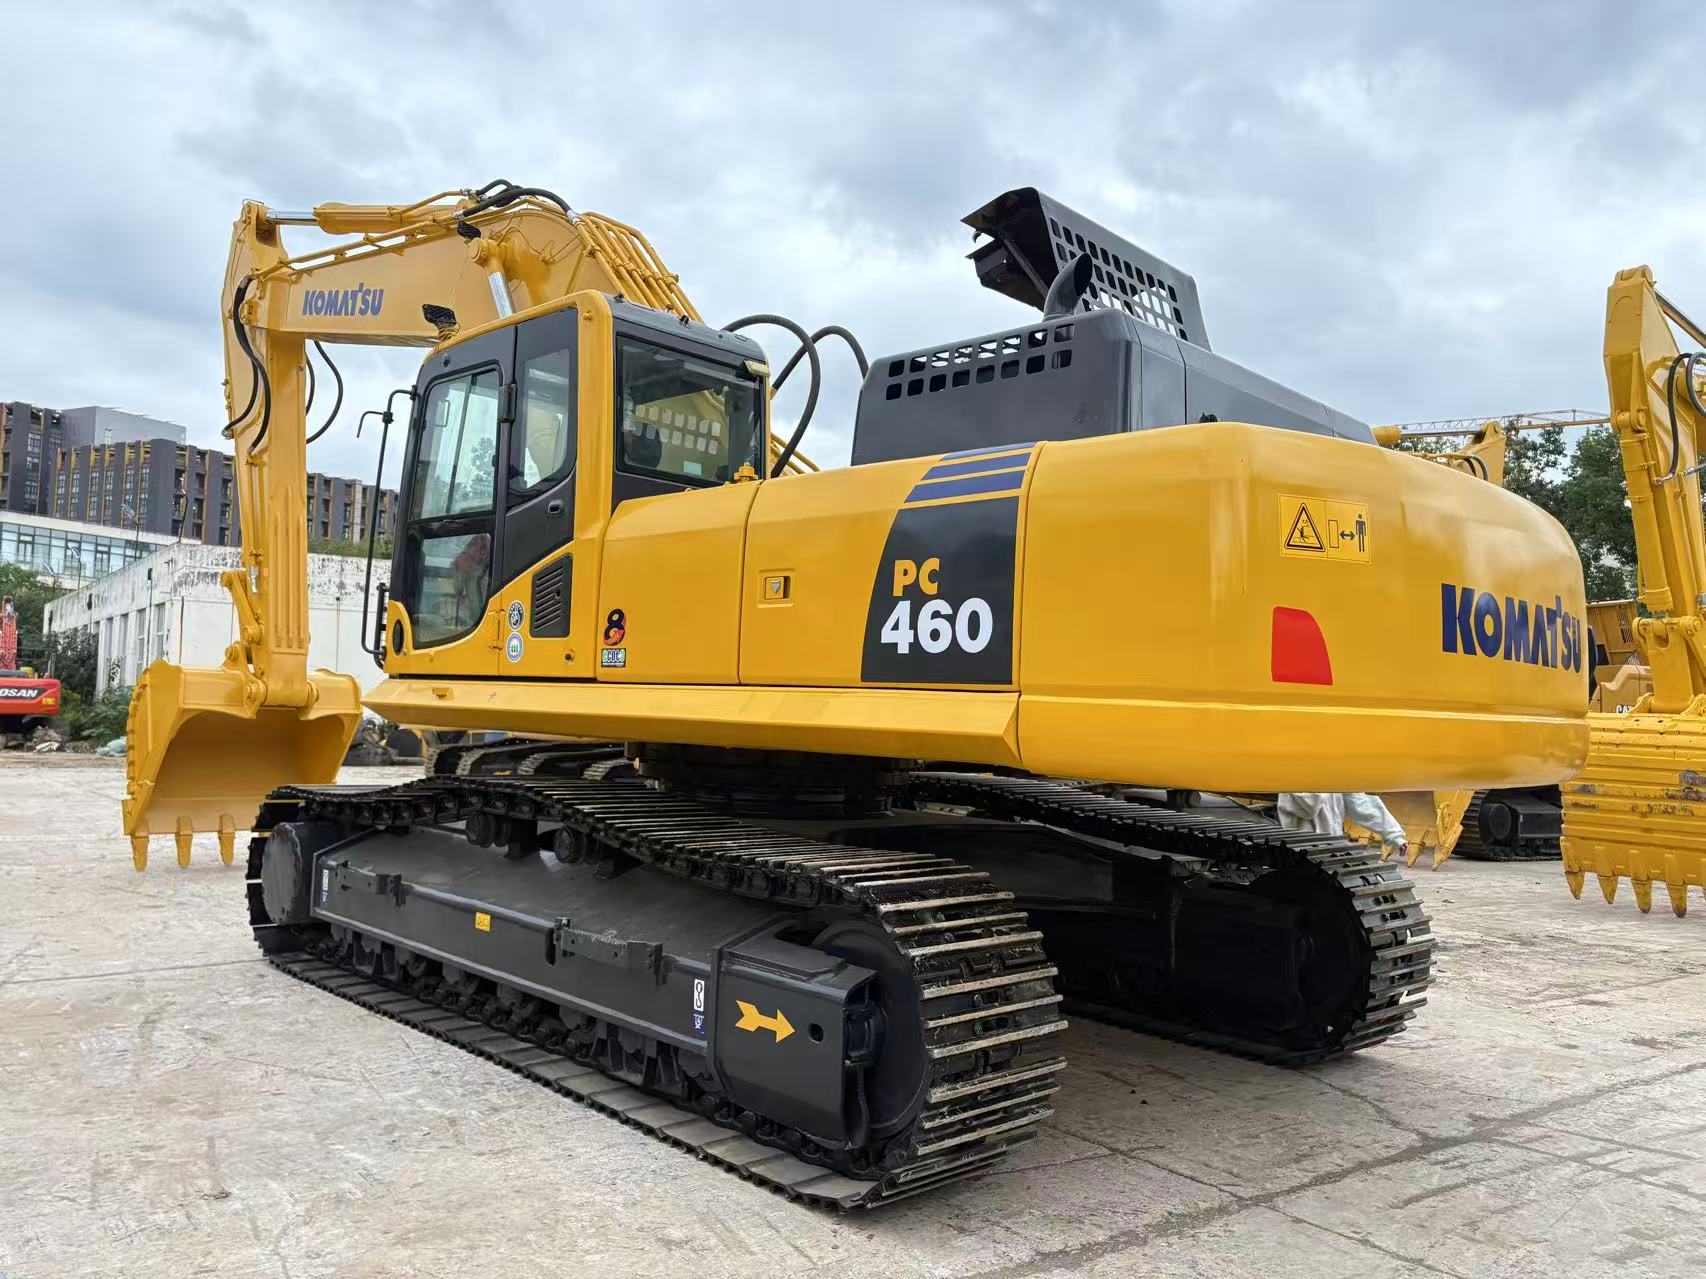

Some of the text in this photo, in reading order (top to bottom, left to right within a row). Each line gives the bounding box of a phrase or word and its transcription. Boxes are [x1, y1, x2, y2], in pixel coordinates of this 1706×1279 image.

[302, 282, 384, 316] KOMATSU
[892, 557, 940, 597] PC
[881, 597, 993, 654] 460
[1441, 583, 1582, 674] KOMATSU
